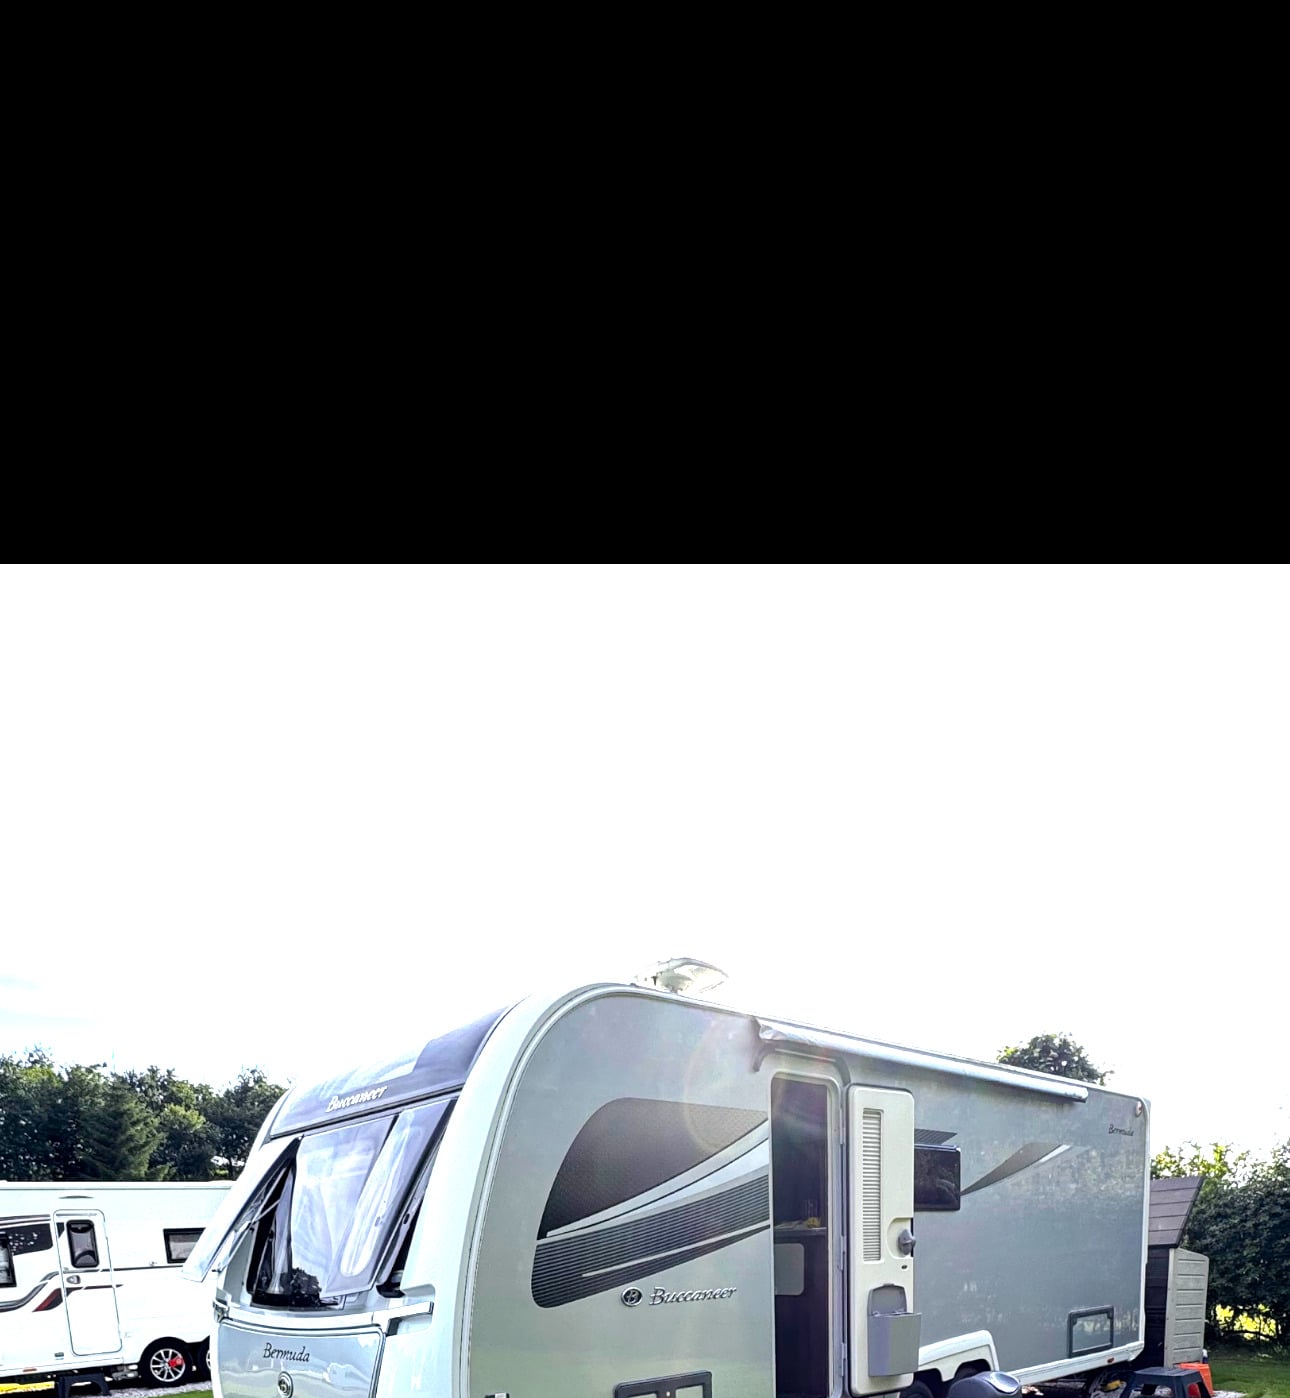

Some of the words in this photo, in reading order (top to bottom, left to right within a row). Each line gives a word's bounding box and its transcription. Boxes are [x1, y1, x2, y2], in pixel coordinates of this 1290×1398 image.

[325, 1085, 388, 1113] Buccaneer
[649, 1286, 737, 1306] Buccaneer
[263, 1342, 310, 1362] Bermuda
